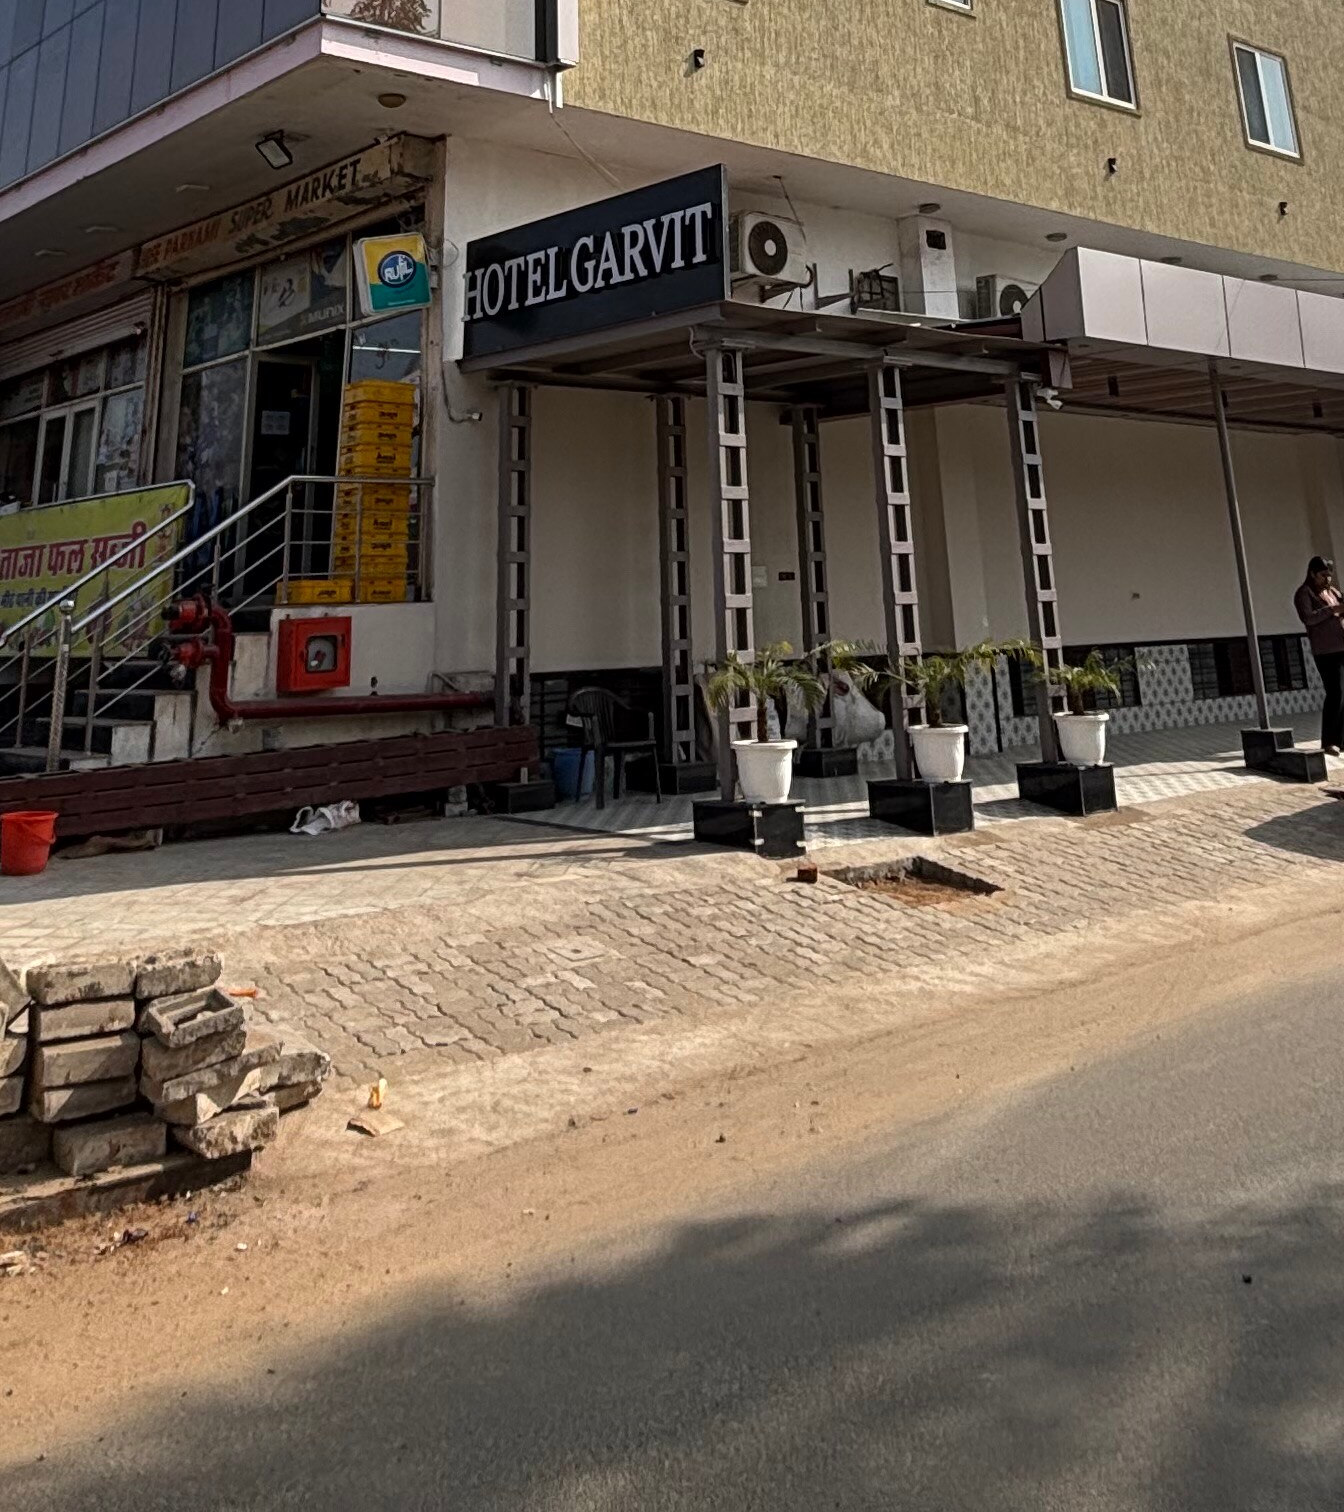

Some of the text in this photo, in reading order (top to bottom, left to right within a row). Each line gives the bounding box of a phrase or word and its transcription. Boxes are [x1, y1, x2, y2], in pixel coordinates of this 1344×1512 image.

[228, 197, 274, 234] SUPER
[284, 157, 360, 213] MARKET
[461, 202, 712, 322] HOTEL GARVIT
[47, 539, 88, 576] फल
